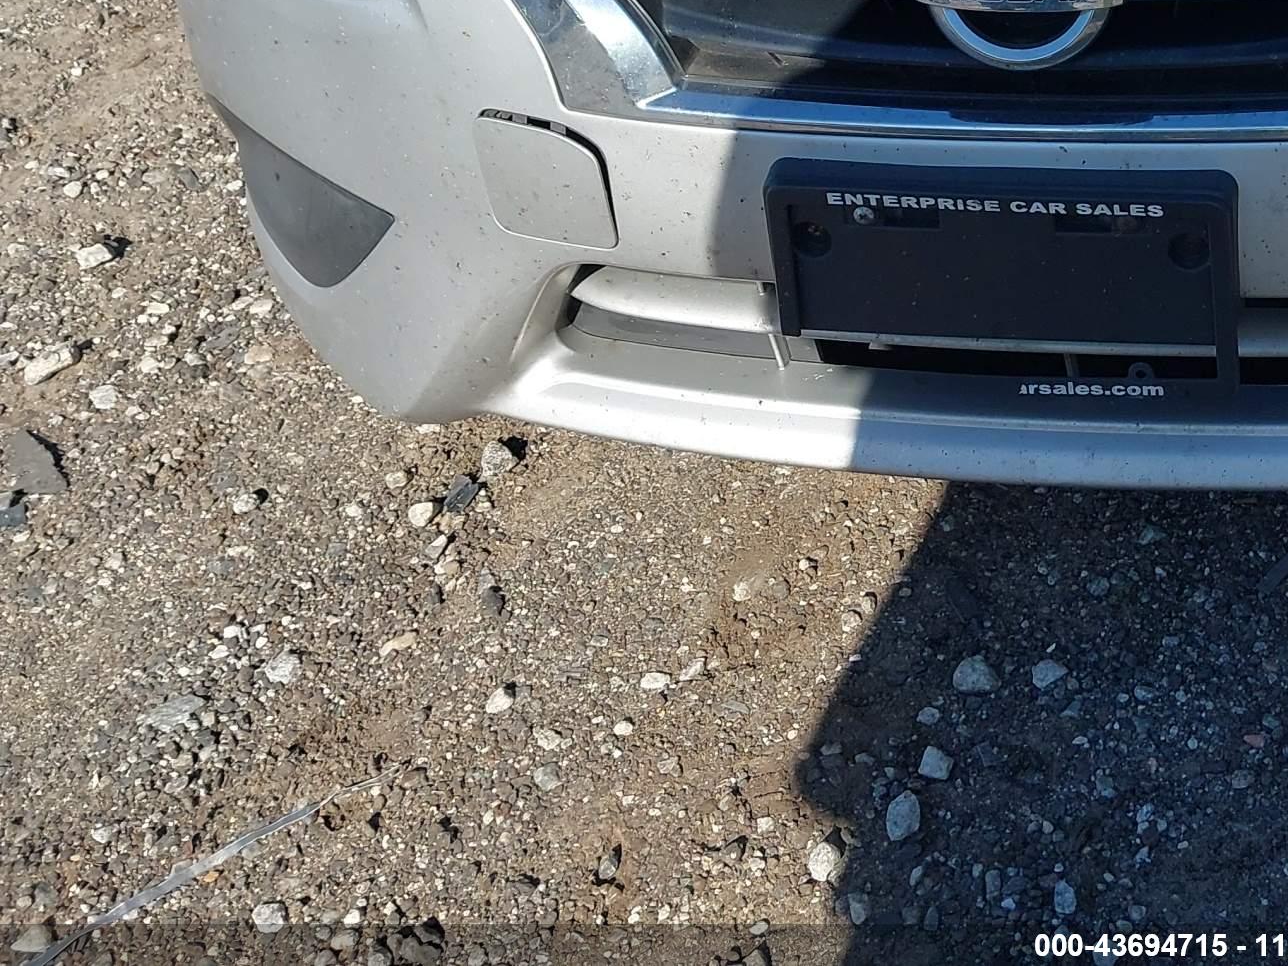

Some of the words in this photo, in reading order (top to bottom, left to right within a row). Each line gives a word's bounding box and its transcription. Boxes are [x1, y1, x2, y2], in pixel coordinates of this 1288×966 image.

[825, 191, 1001, 213] ENTERPRISE
[1009, 201, 1067, 215] CAR
[1075, 202, 1164, 218] SALES
